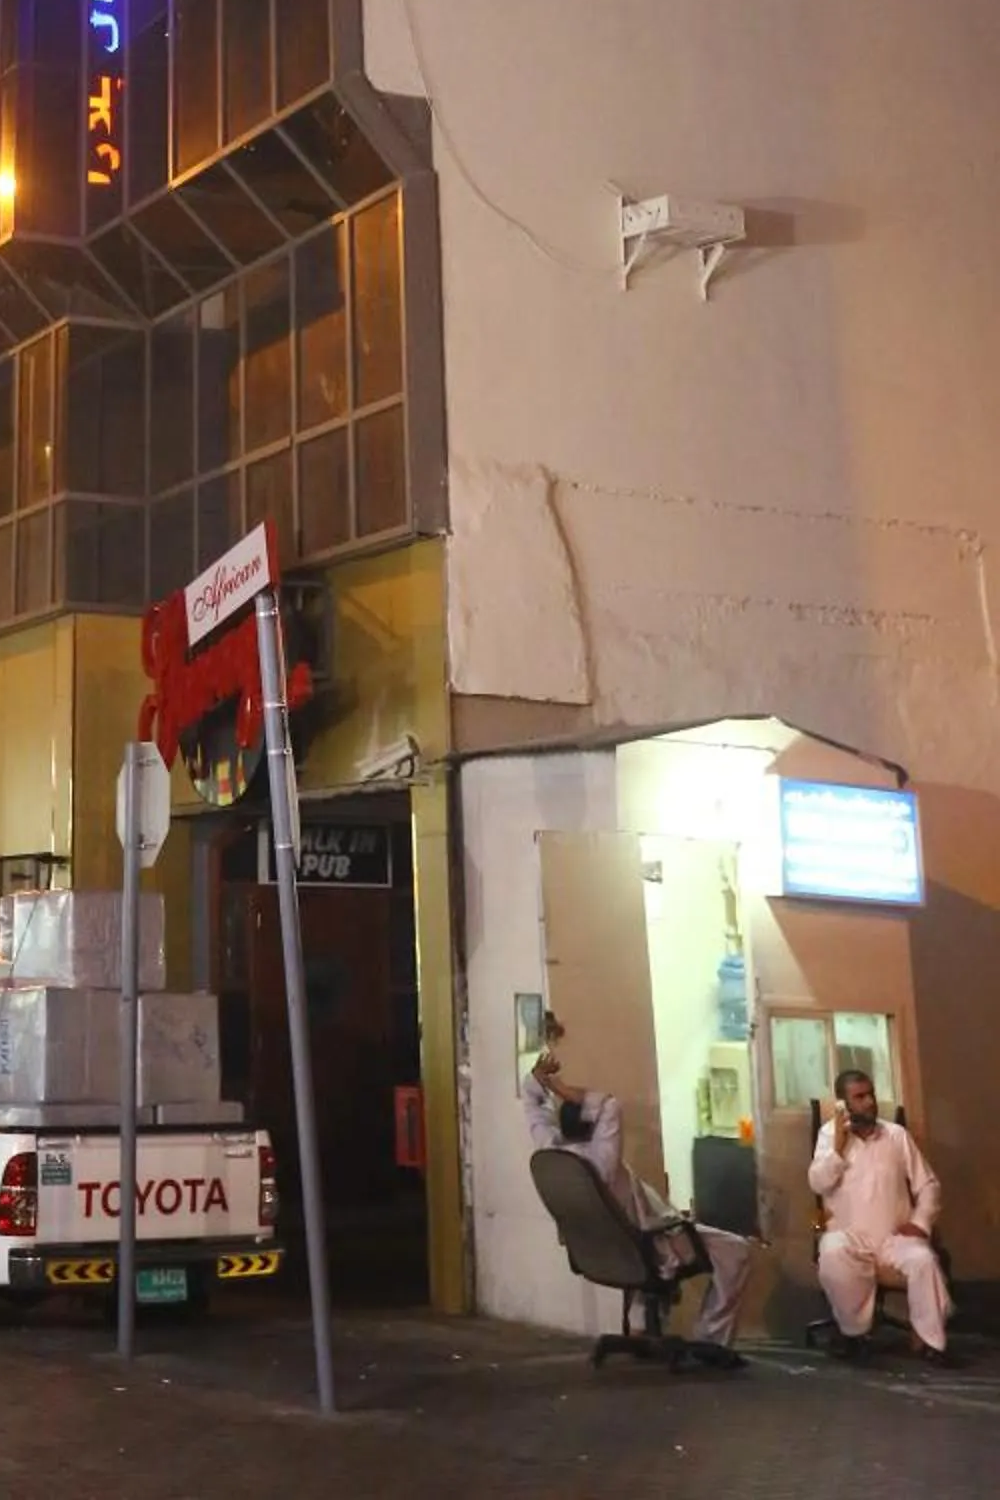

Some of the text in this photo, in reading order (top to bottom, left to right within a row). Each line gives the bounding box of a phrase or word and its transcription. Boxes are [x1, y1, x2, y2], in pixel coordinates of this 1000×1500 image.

[192, 555, 261, 622] African
[299, 830, 343, 853] ALK
[302, 853, 351, 879] PUB
[77, 1177, 229, 1218] TOYOTA
